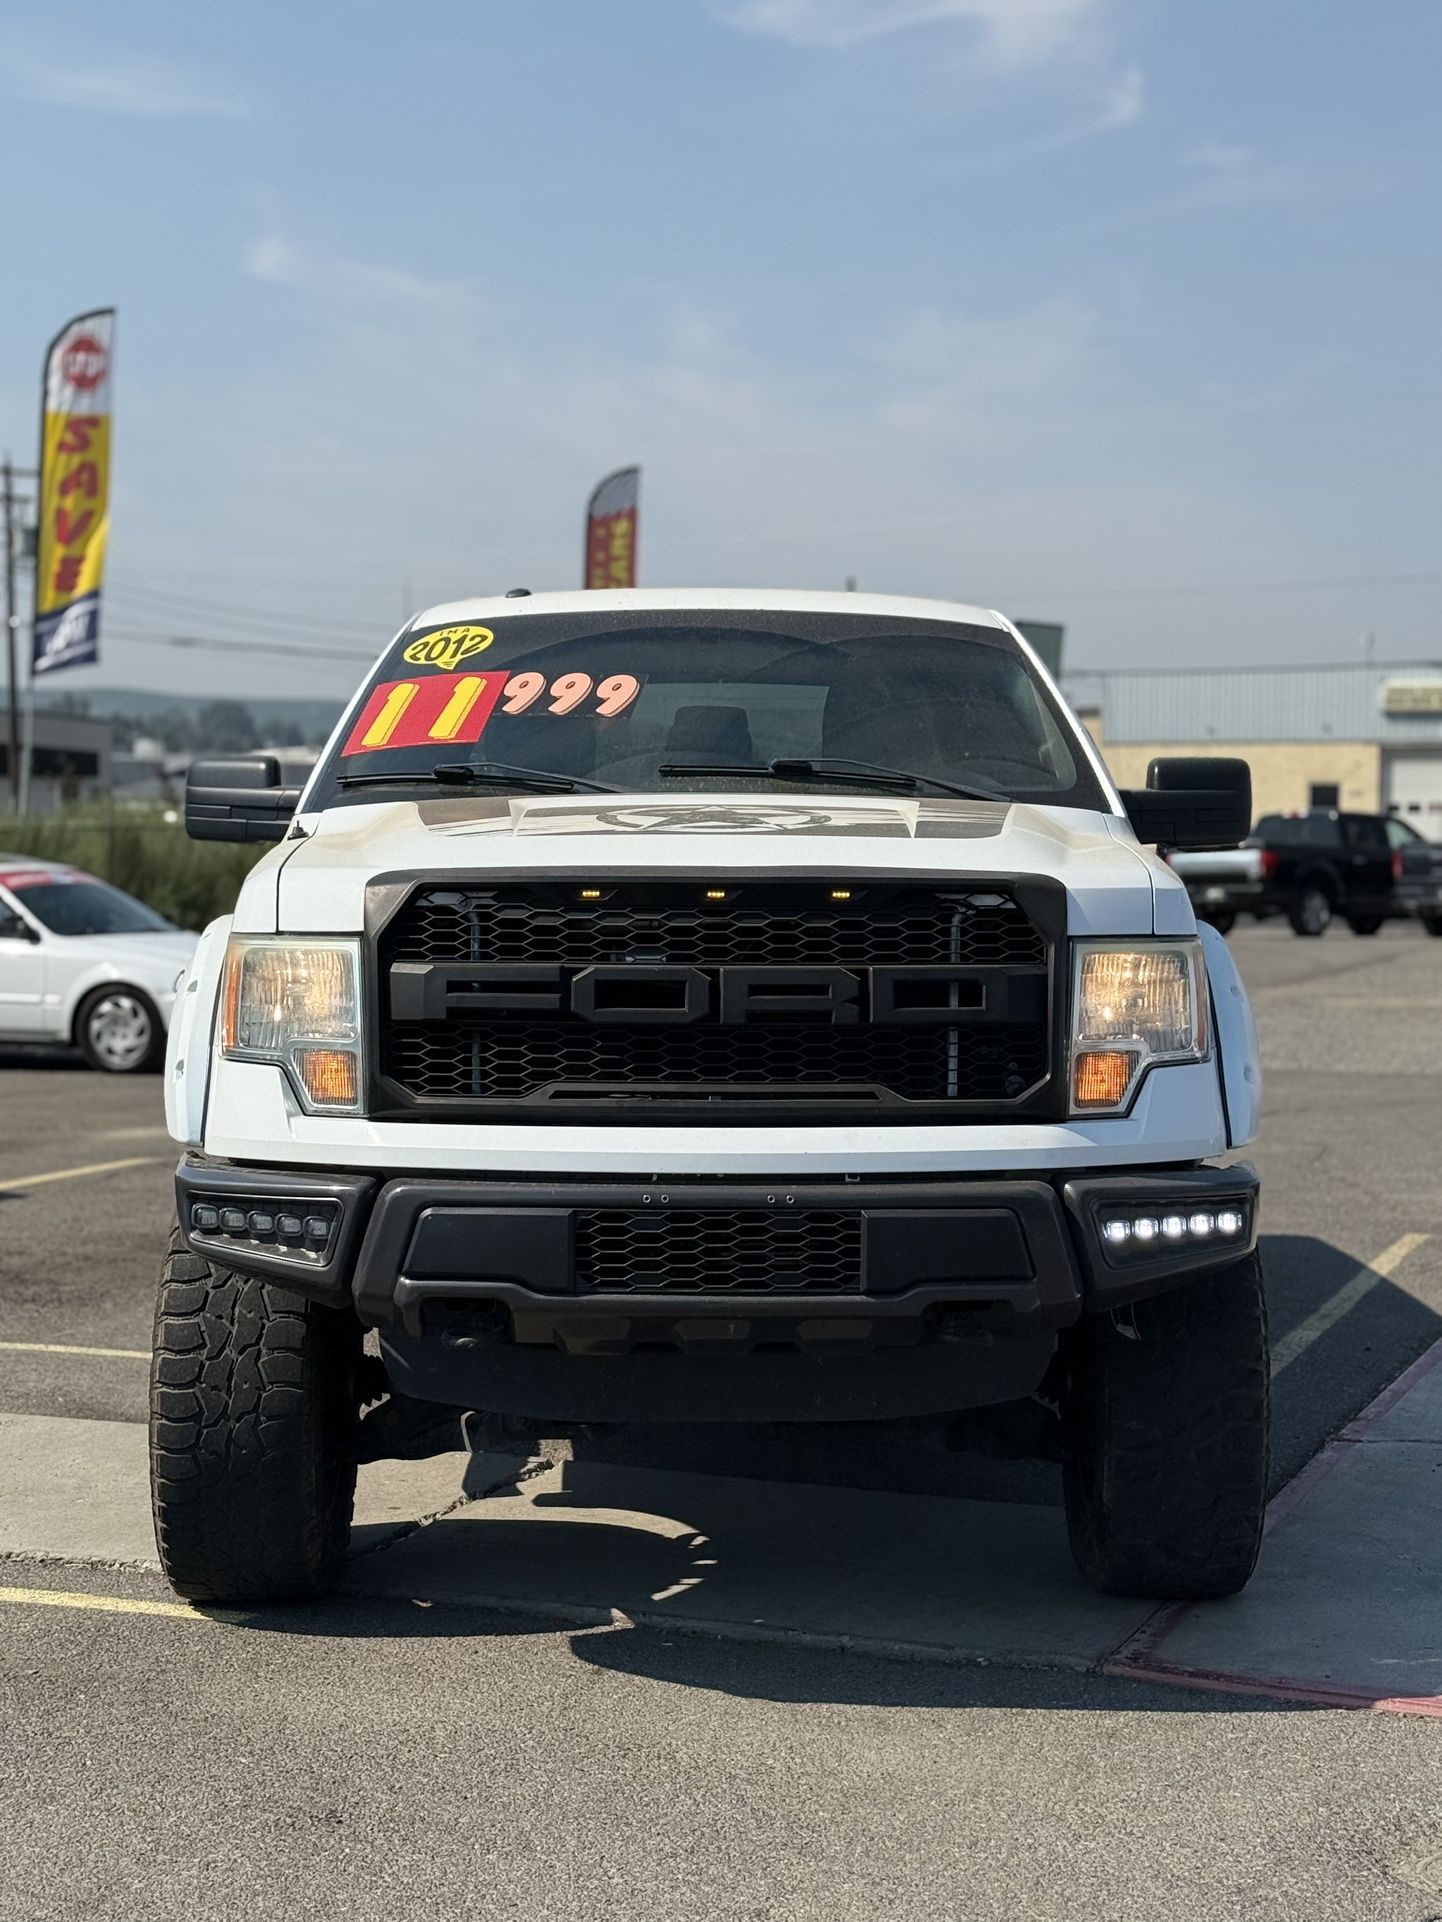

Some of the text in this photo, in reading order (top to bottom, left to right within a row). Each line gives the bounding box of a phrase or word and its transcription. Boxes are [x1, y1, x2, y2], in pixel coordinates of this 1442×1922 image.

[55, 416, 100, 593] SAVE
[408, 633, 489, 662] 2012
[360, 671, 641, 748] 11 999
[390, 963, 1015, 1024] FORD
